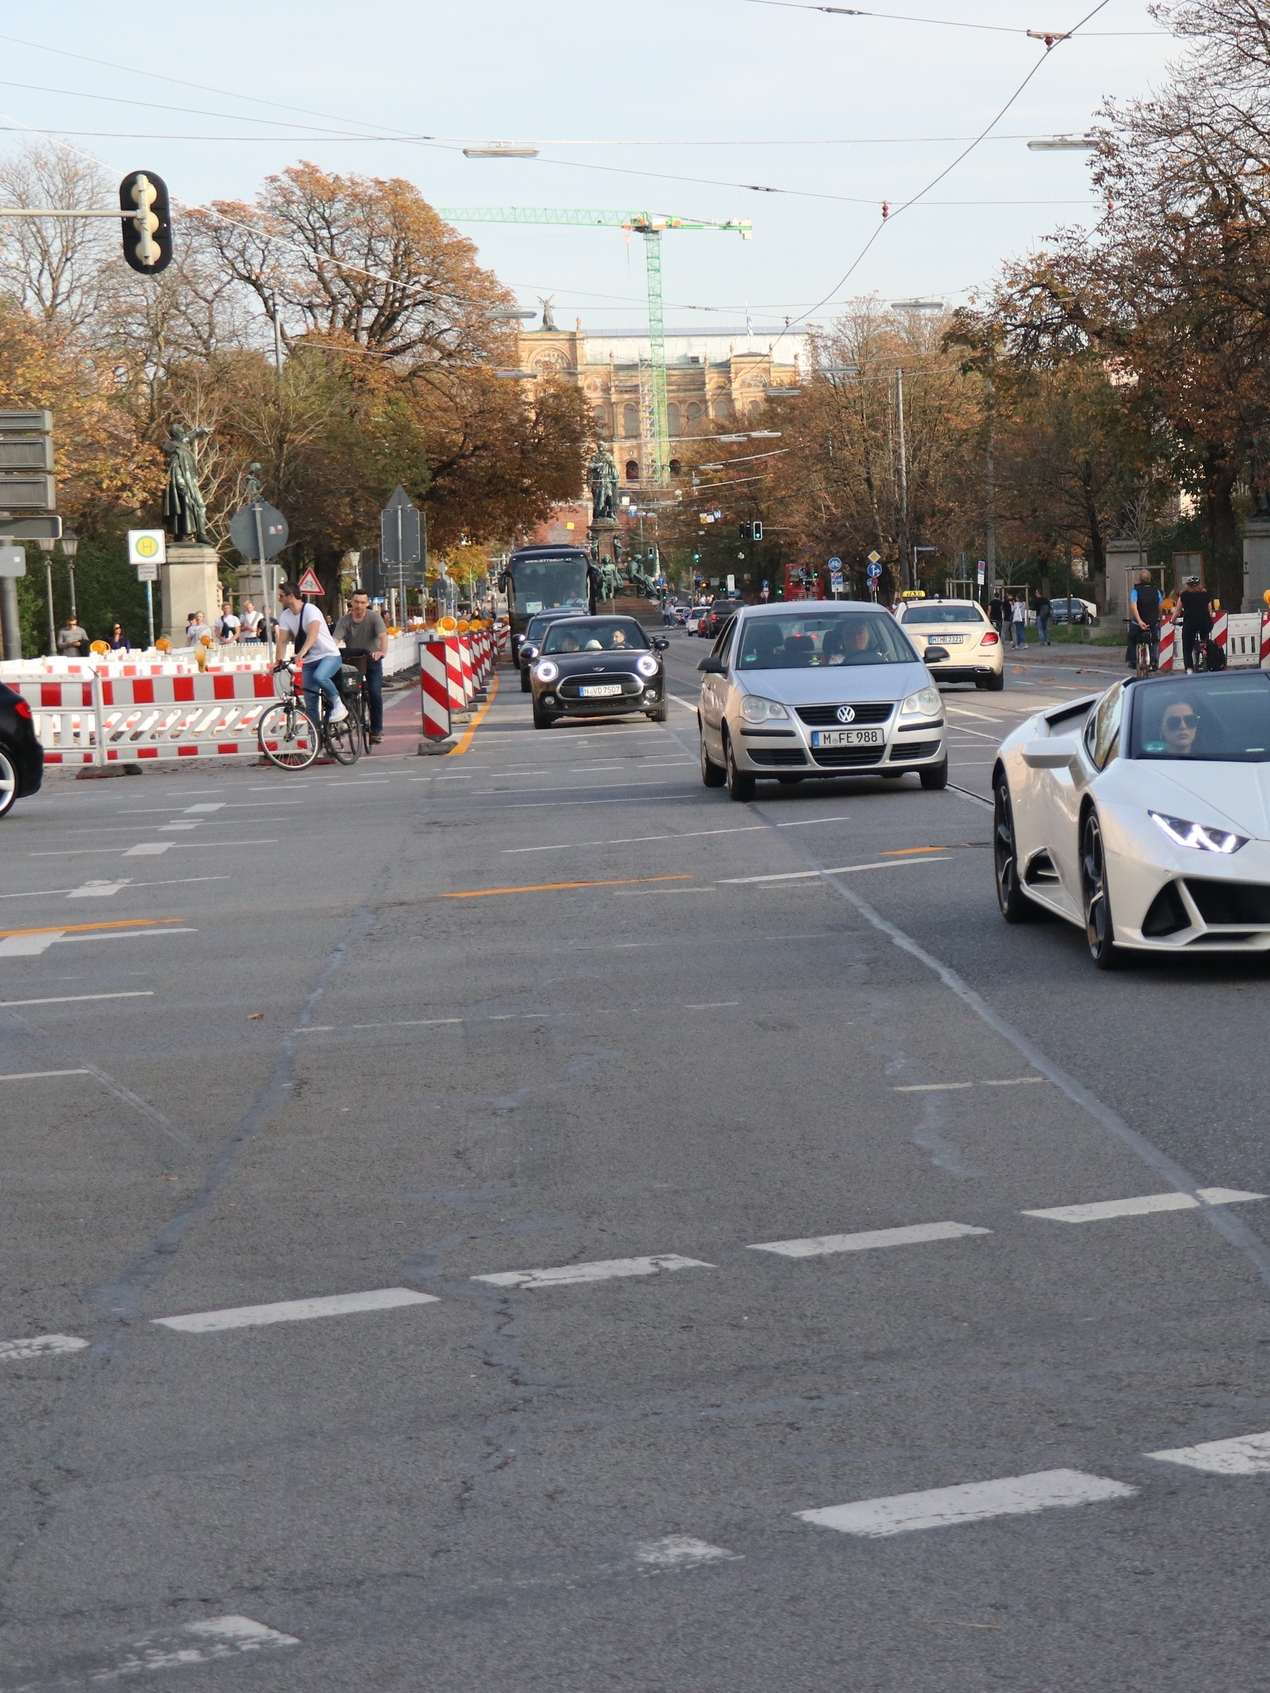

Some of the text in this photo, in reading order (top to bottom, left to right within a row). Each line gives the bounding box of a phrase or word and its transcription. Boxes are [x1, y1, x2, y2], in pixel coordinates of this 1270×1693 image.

[824, 731, 878, 744] M FE 988
